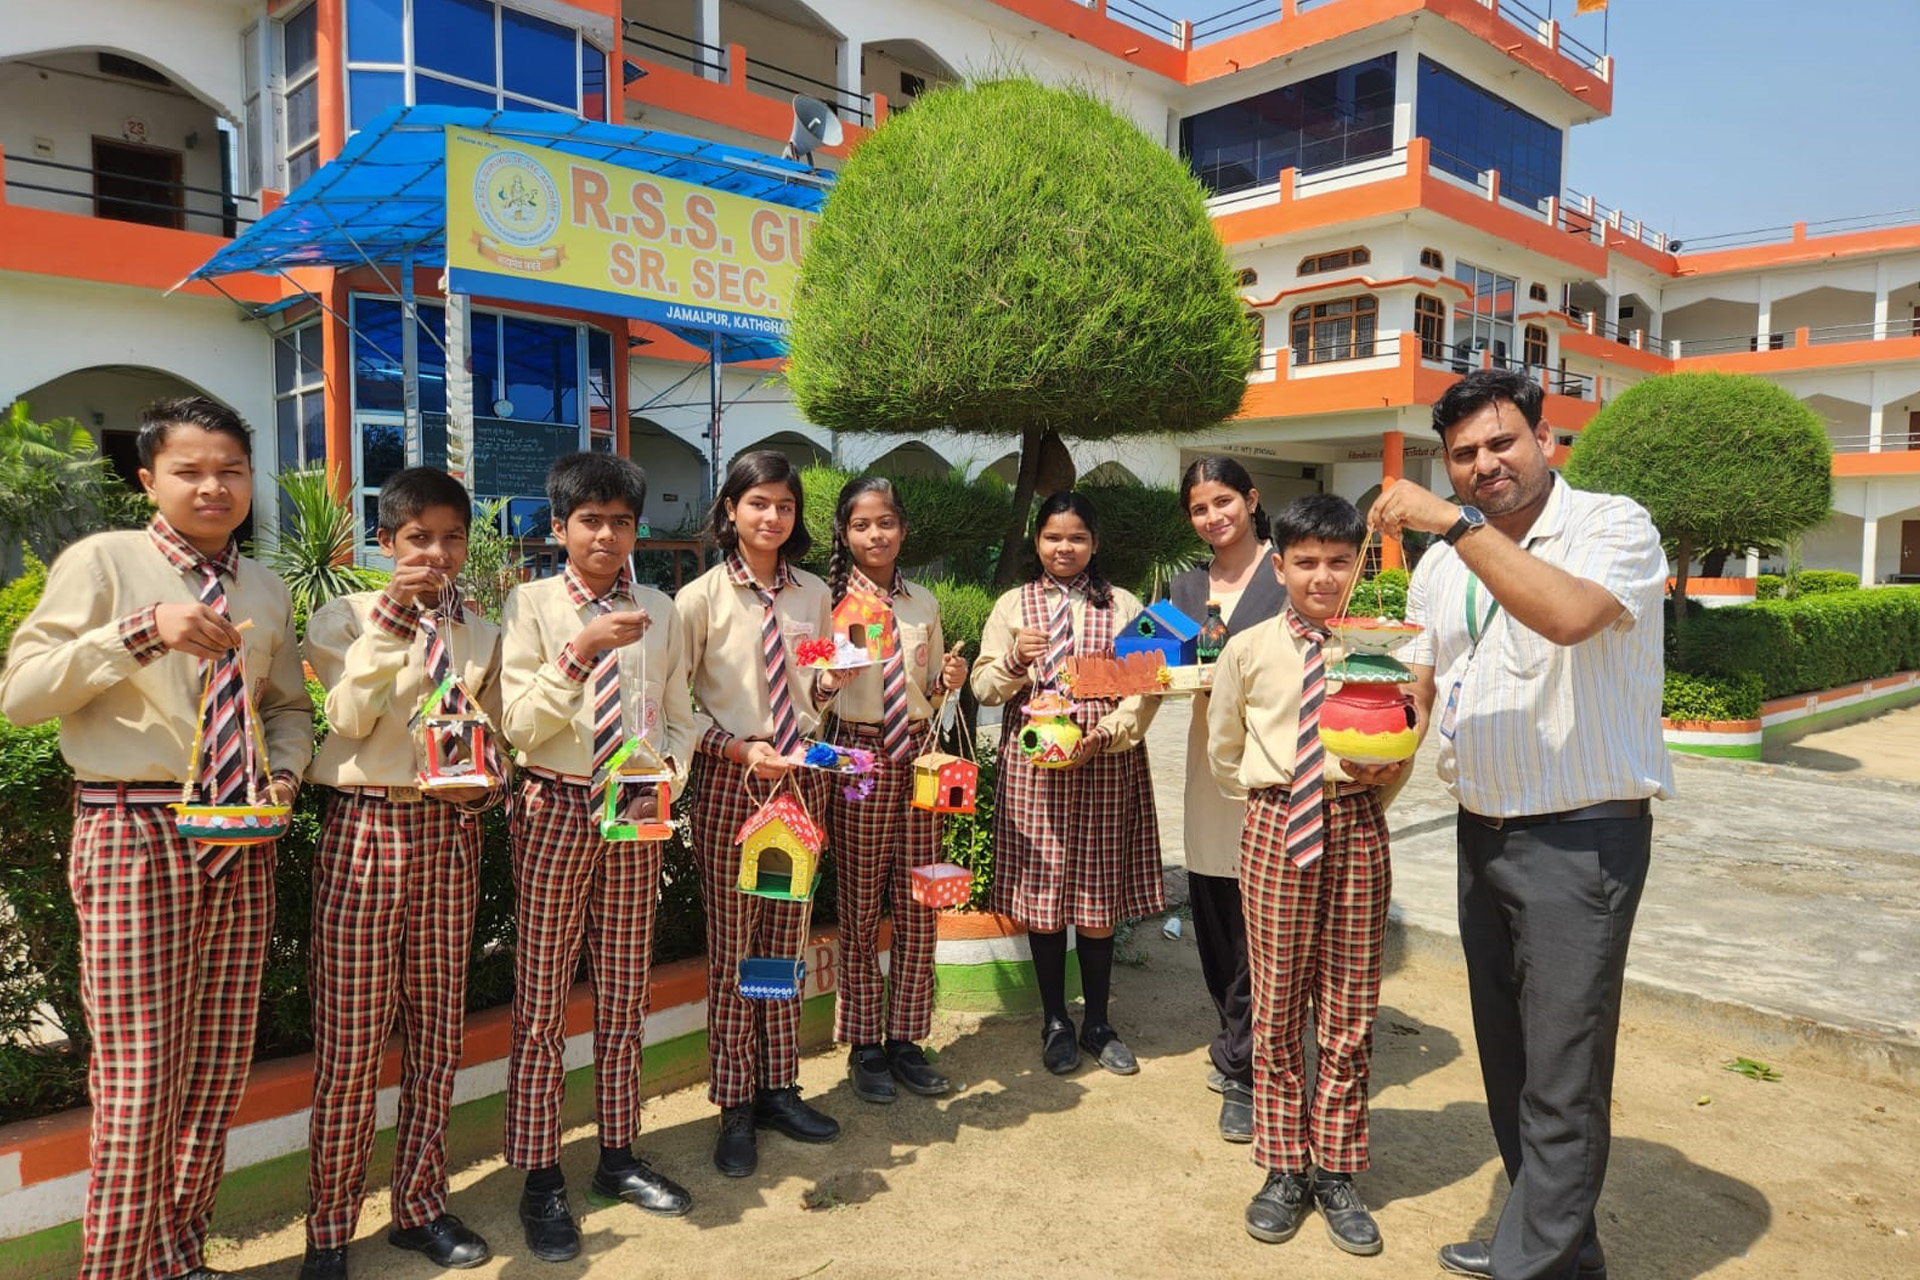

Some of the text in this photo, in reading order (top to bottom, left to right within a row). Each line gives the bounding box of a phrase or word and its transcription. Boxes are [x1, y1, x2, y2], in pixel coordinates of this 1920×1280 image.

[569, 163, 735, 256] R.S.S.
[610, 242, 679, 295] SR.
[691, 257, 778, 311] SEC.
[666, 306, 731, 329] JAMALPUR,
[816, 947, 835, 992] B
